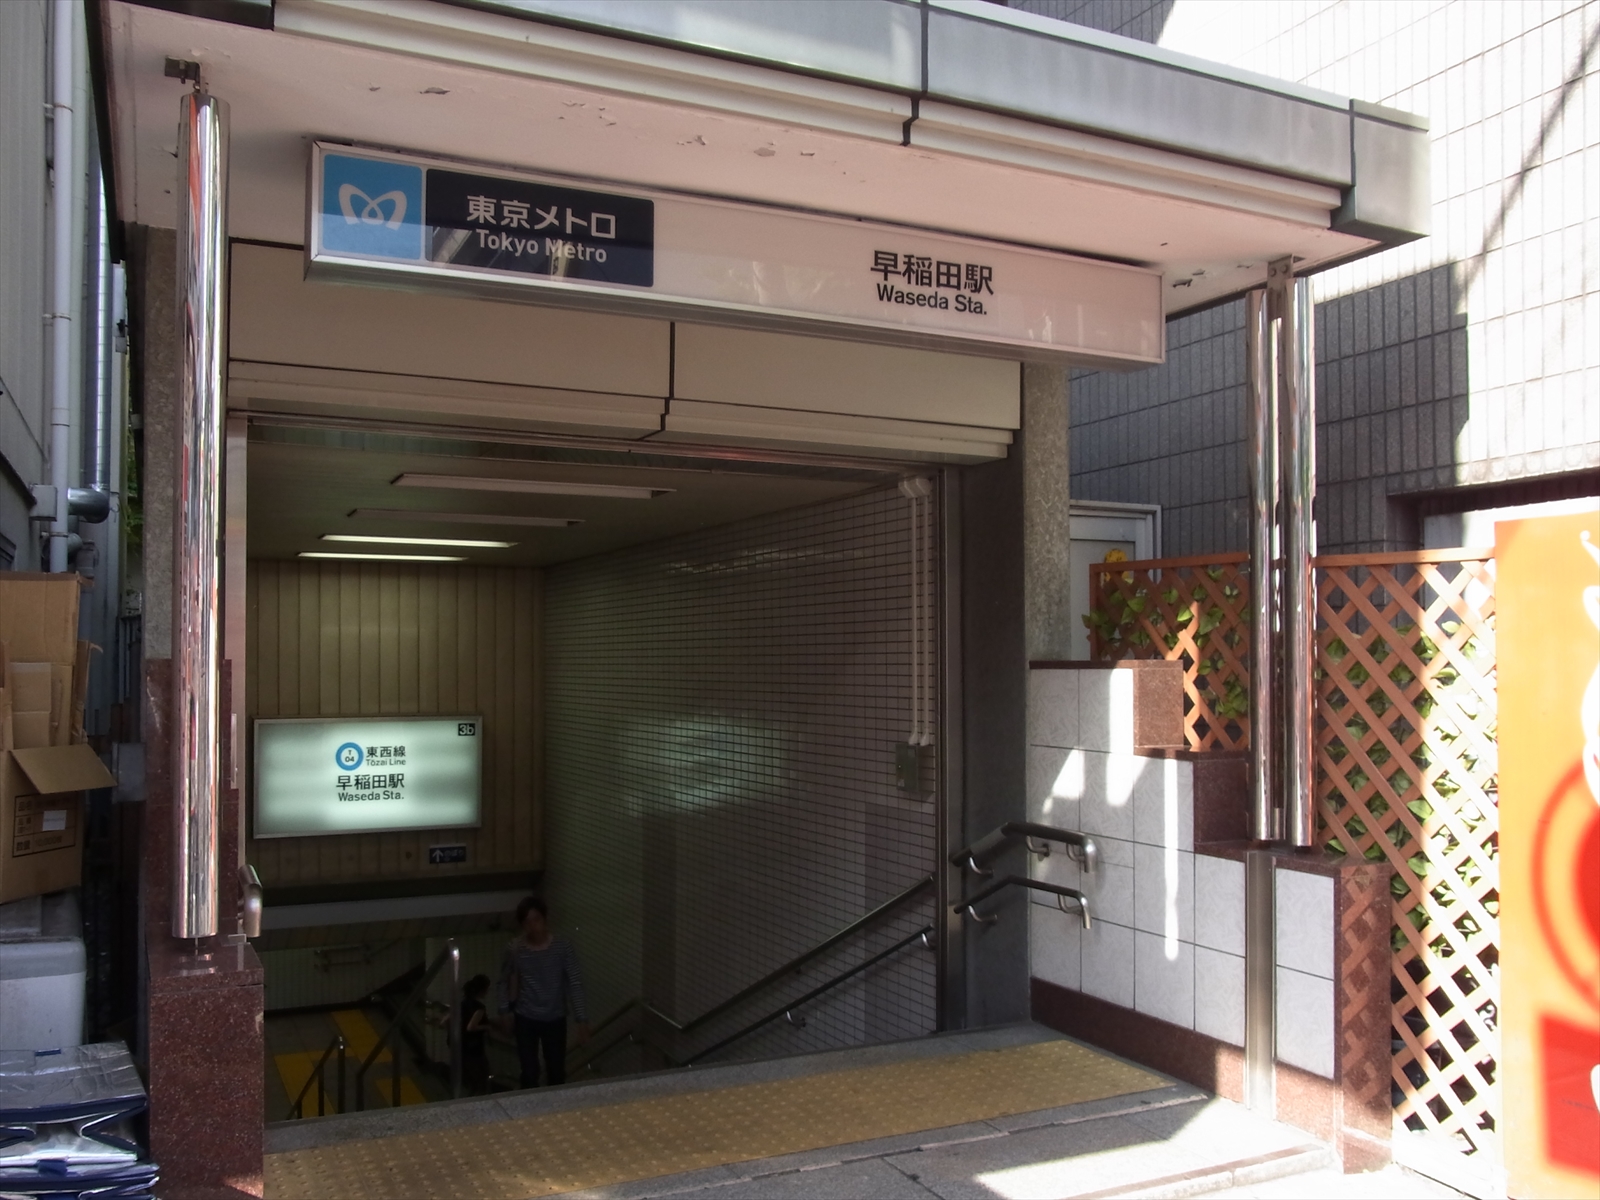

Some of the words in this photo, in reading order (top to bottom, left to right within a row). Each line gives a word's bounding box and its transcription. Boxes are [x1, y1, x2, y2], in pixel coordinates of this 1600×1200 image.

[466, 195, 616, 240] 東京メトロ
[475, 228, 539, 257] Tokyo
[545, 237, 607, 263] Metro
[870, 250, 994, 296] 早稲田駅
[876, 283, 949, 310] Waseda
[954, 294, 987, 315] Sta.
[459, 724, 474, 735] 3b
[366, 745, 406, 758] 東西線
[389, 758, 406, 766] Line
[336, 773, 405, 791] 早稲田駅
[338, 791, 381, 801] Waseda
[383, 790, 405, 800] Sta.
